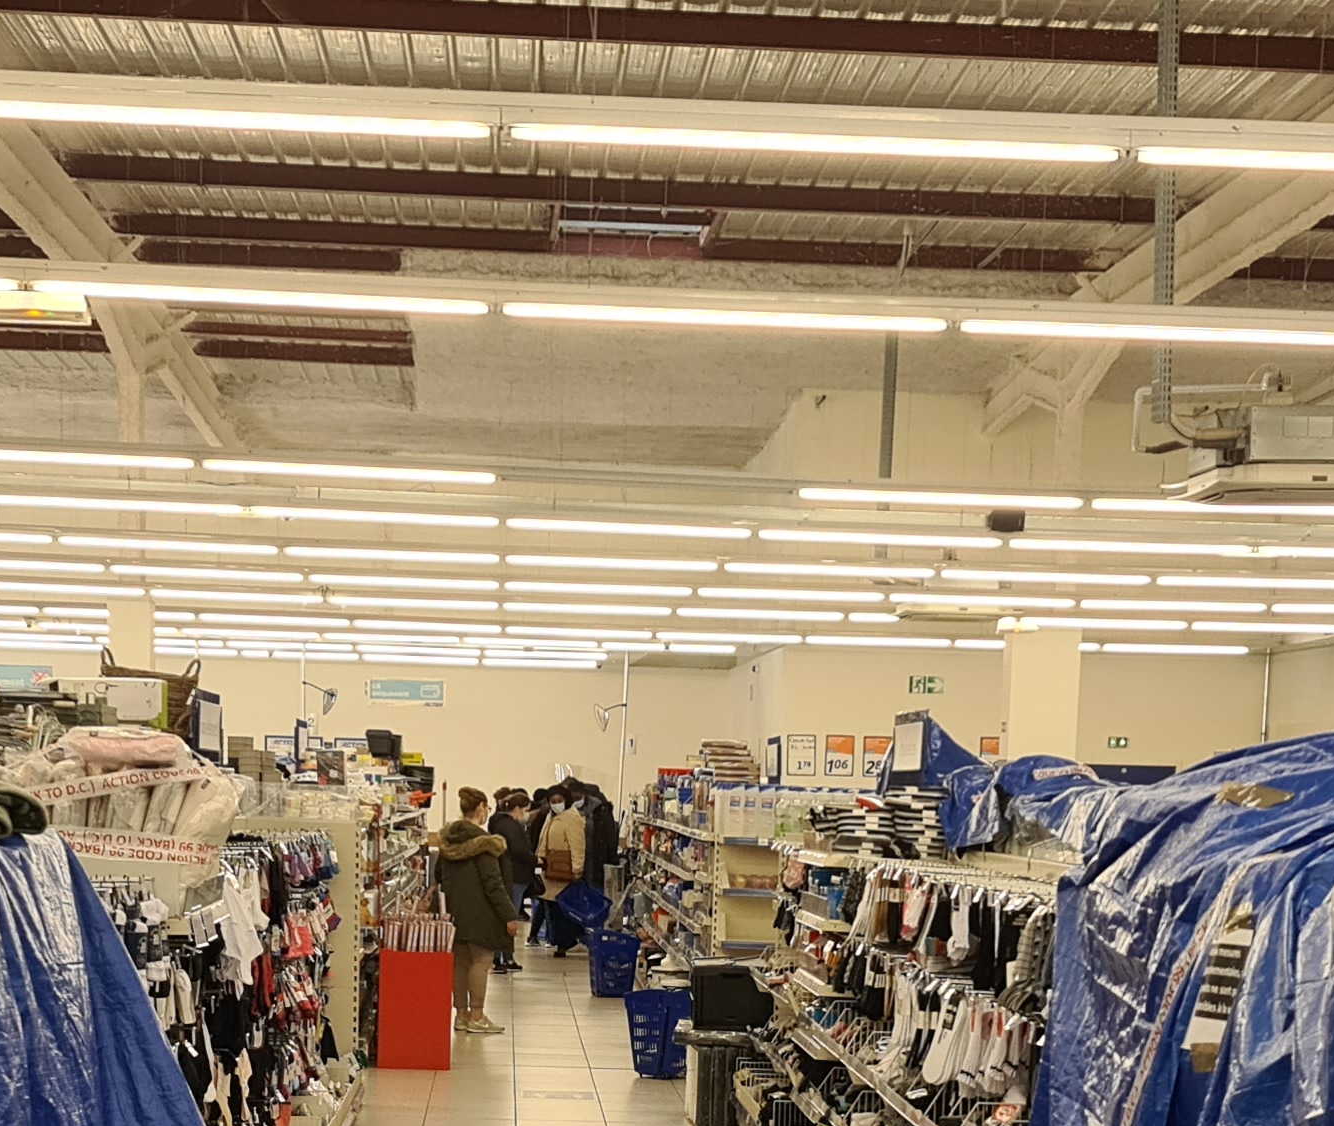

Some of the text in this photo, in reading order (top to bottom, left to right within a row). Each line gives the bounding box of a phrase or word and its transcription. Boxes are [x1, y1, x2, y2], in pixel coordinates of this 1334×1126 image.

[307, 717, 315, 728] 2
[826, 759, 849, 773] 106
[44, 786, 63, 800] TO
[102, 771, 150, 790] ACTION
